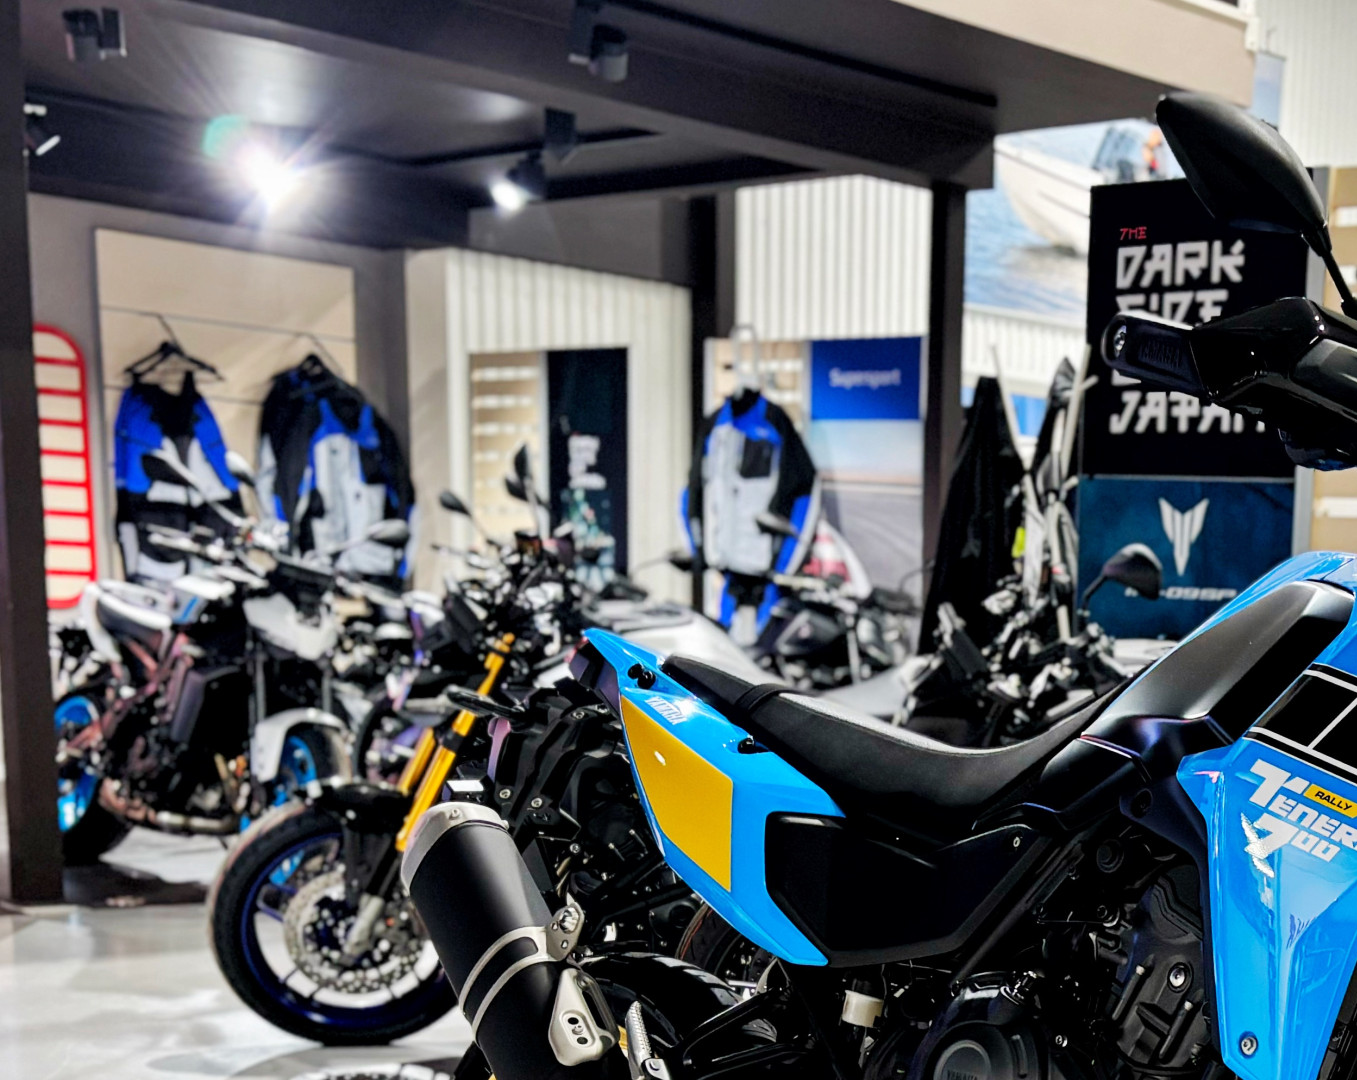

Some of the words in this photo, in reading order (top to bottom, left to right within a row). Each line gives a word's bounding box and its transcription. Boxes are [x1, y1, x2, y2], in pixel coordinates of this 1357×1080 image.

[1119, 226, 1147, 240] THE
[1115, 239, 1246, 290] DARK
[644, 696, 688, 726] YAMAHA
[1313, 790, 1353, 812] RALLY
[1246, 812, 1341, 864] 700
